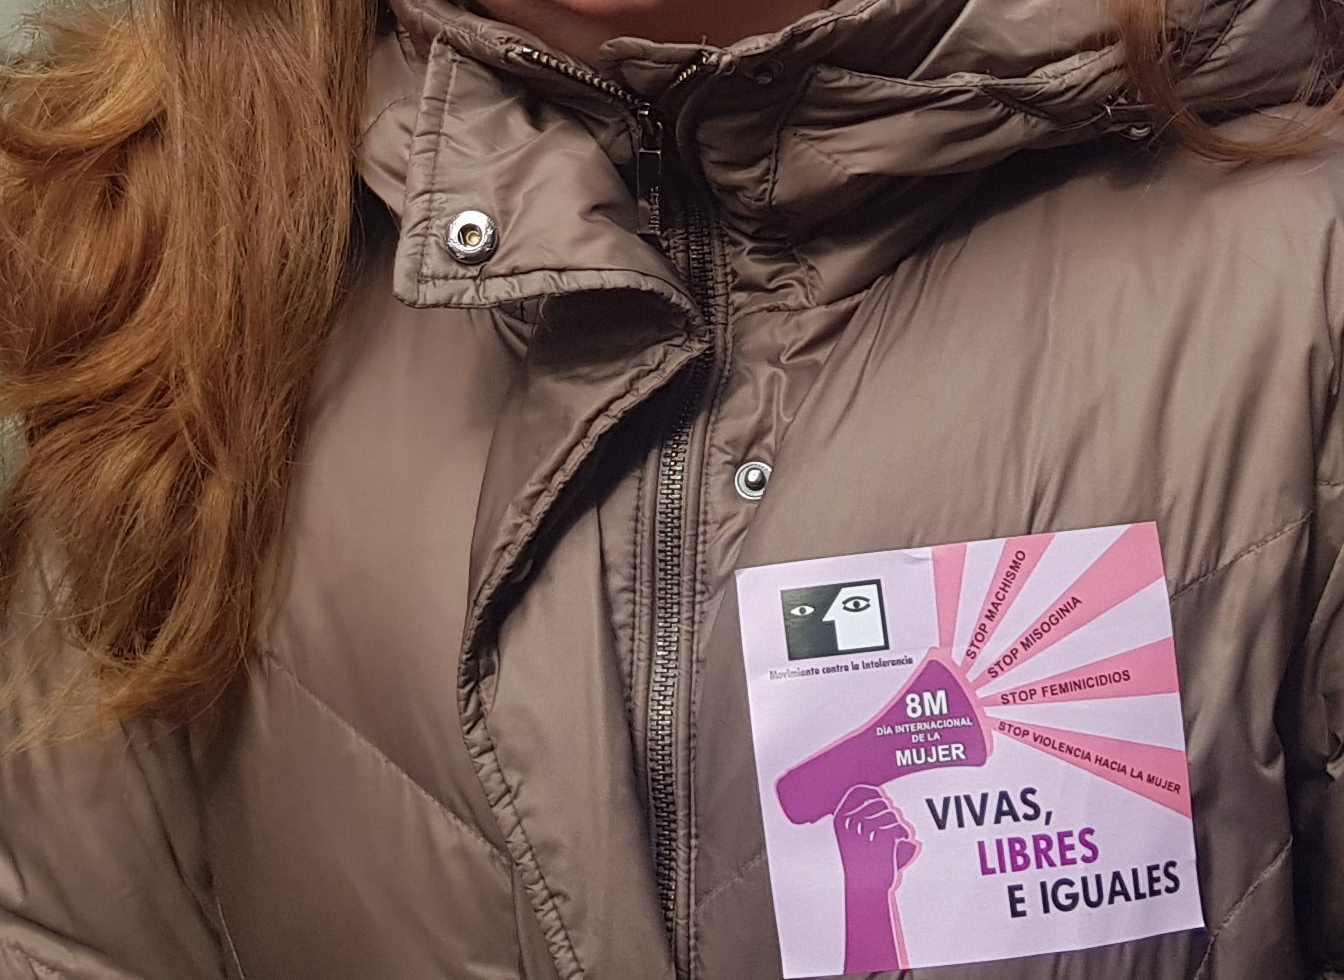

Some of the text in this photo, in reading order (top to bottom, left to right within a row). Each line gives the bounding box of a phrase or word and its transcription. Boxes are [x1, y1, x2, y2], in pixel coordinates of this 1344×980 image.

[965, 550, 1026, 661] STOP MACHISMO
[987, 596, 1083, 679] STOP MISOGINIA
[905, 689, 949, 719] 8M
[1000, 669, 1132, 706] STOP FEMINICIDIOS
[895, 717, 974, 734] INTERNACIONAL
[911, 732, 941, 743] DE LA
[895, 743, 967, 767] MUJER
[998, 721, 1182, 795] STOP VIOLENCIA HACIA LA MUJER
[925, 787, 1053, 831] VIVAS,
[977, 827, 1099, 876] LIBRES
[1007, 860, 1181, 919] E IGUALES
